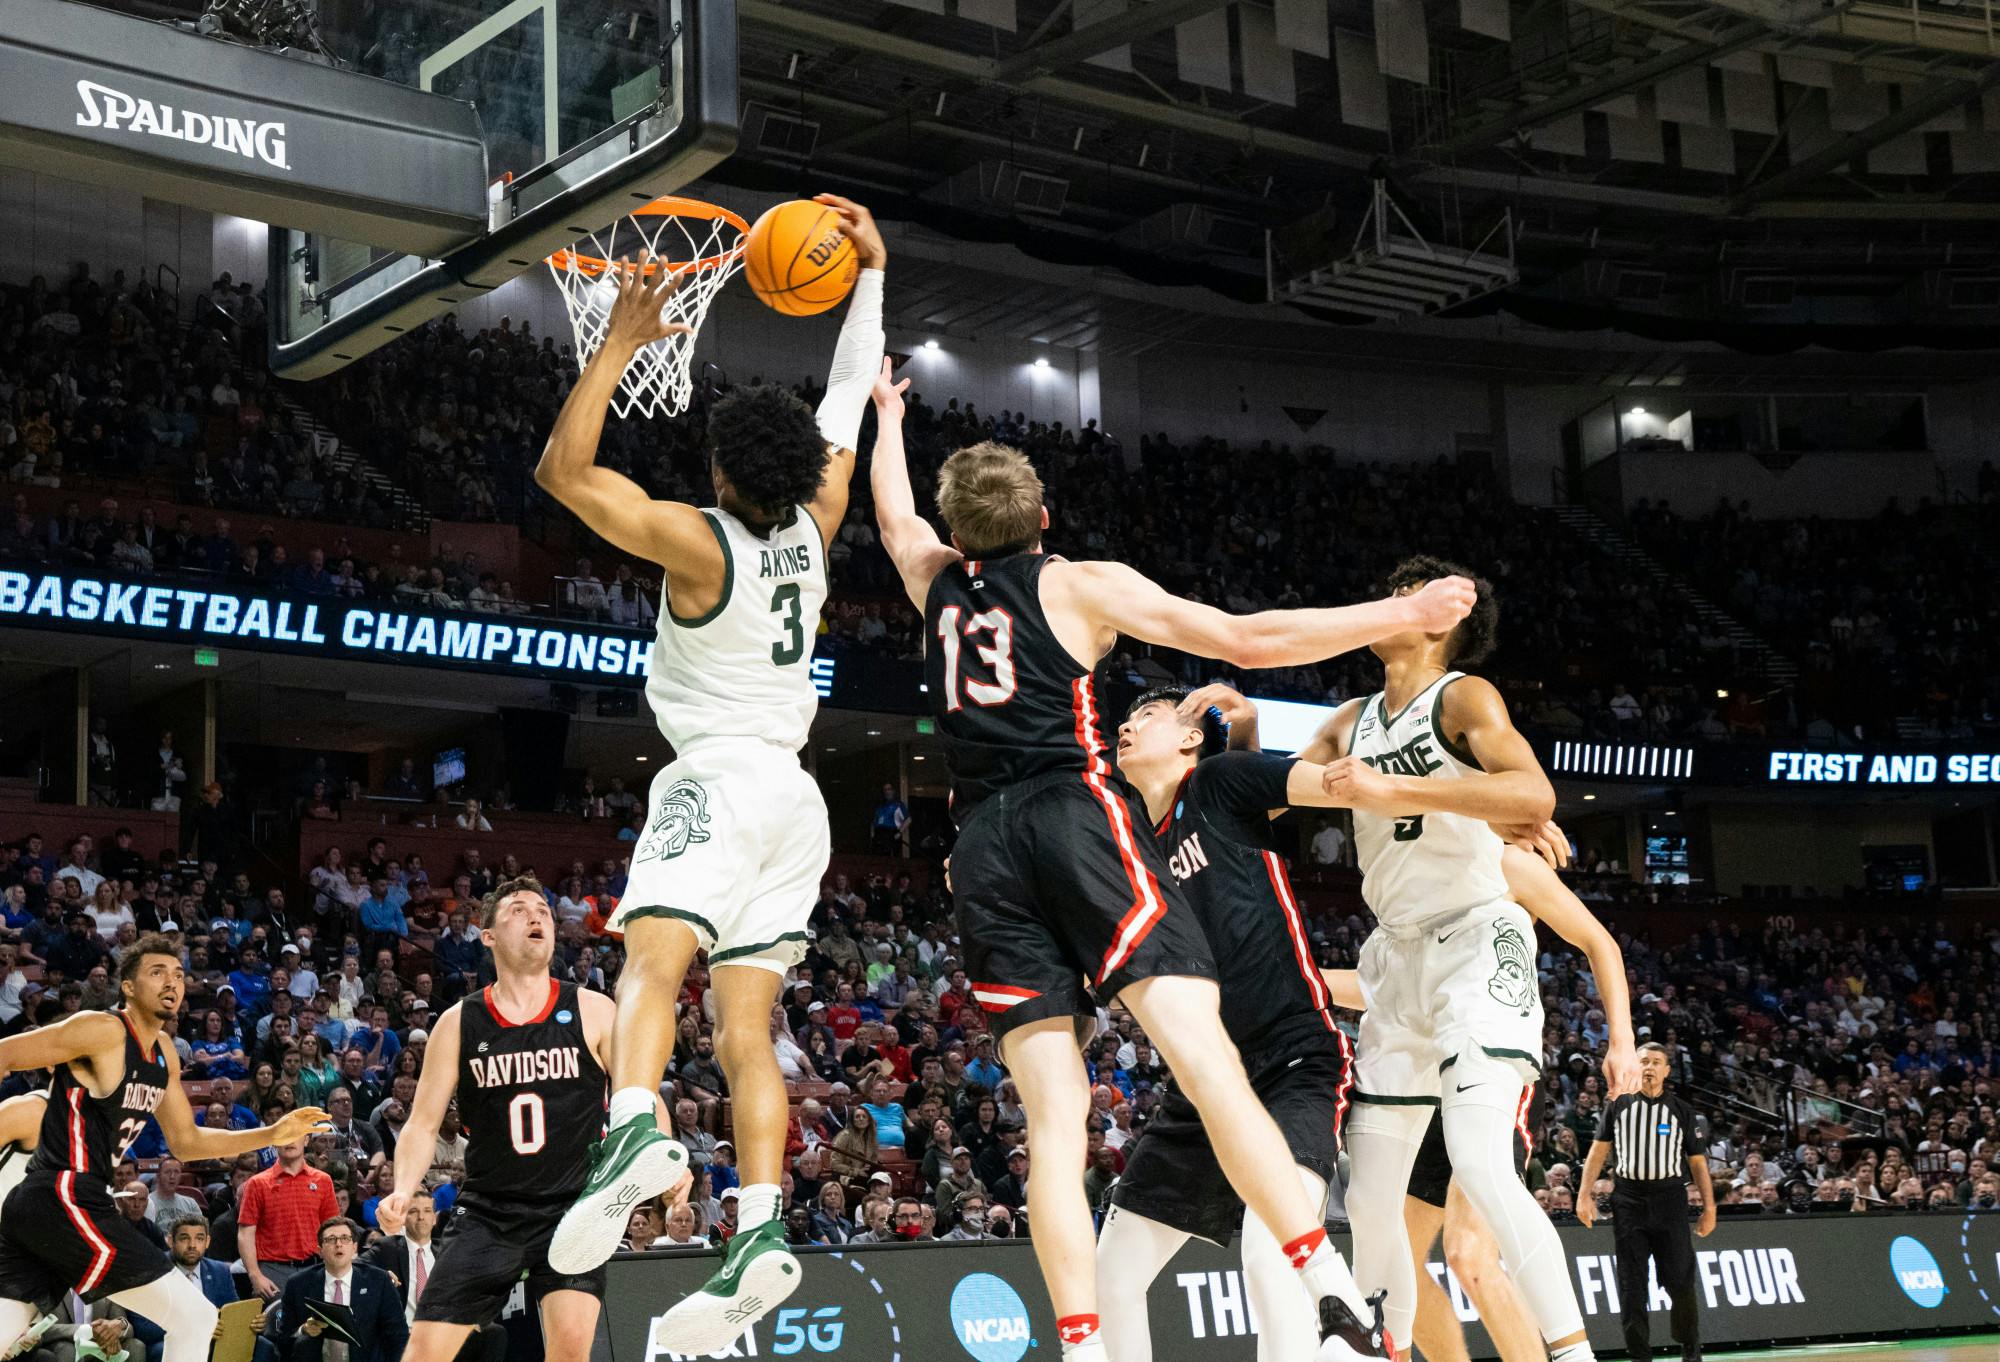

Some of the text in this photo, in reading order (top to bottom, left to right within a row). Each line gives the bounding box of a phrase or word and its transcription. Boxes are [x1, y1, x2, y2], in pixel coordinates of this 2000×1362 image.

[77, 79, 288, 170] SPALDING
[759, 544, 811, 578] AKINS
[0, 571, 656, 677] BASKETBALL CHAMPIONSH
[770, 582, 804, 666] 3
[937, 604, 1018, 712] 13
[1769, 751, 1863, 782] FIRST
[1868, 754, 1937, 783] AND
[469, 1046, 580, 1088] DAVIDSON
[121, 1082, 166, 1114] DAVIDSO
[508, 1091, 547, 1156] 0
[1176, 1269, 1259, 1339] TH
[1696, 1247, 1806, 1309] FOUR
[1901, 1269, 1945, 1290] NCAA
[773, 1306, 844, 1356] 5G
[963, 1316, 1031, 1344] NCAA
